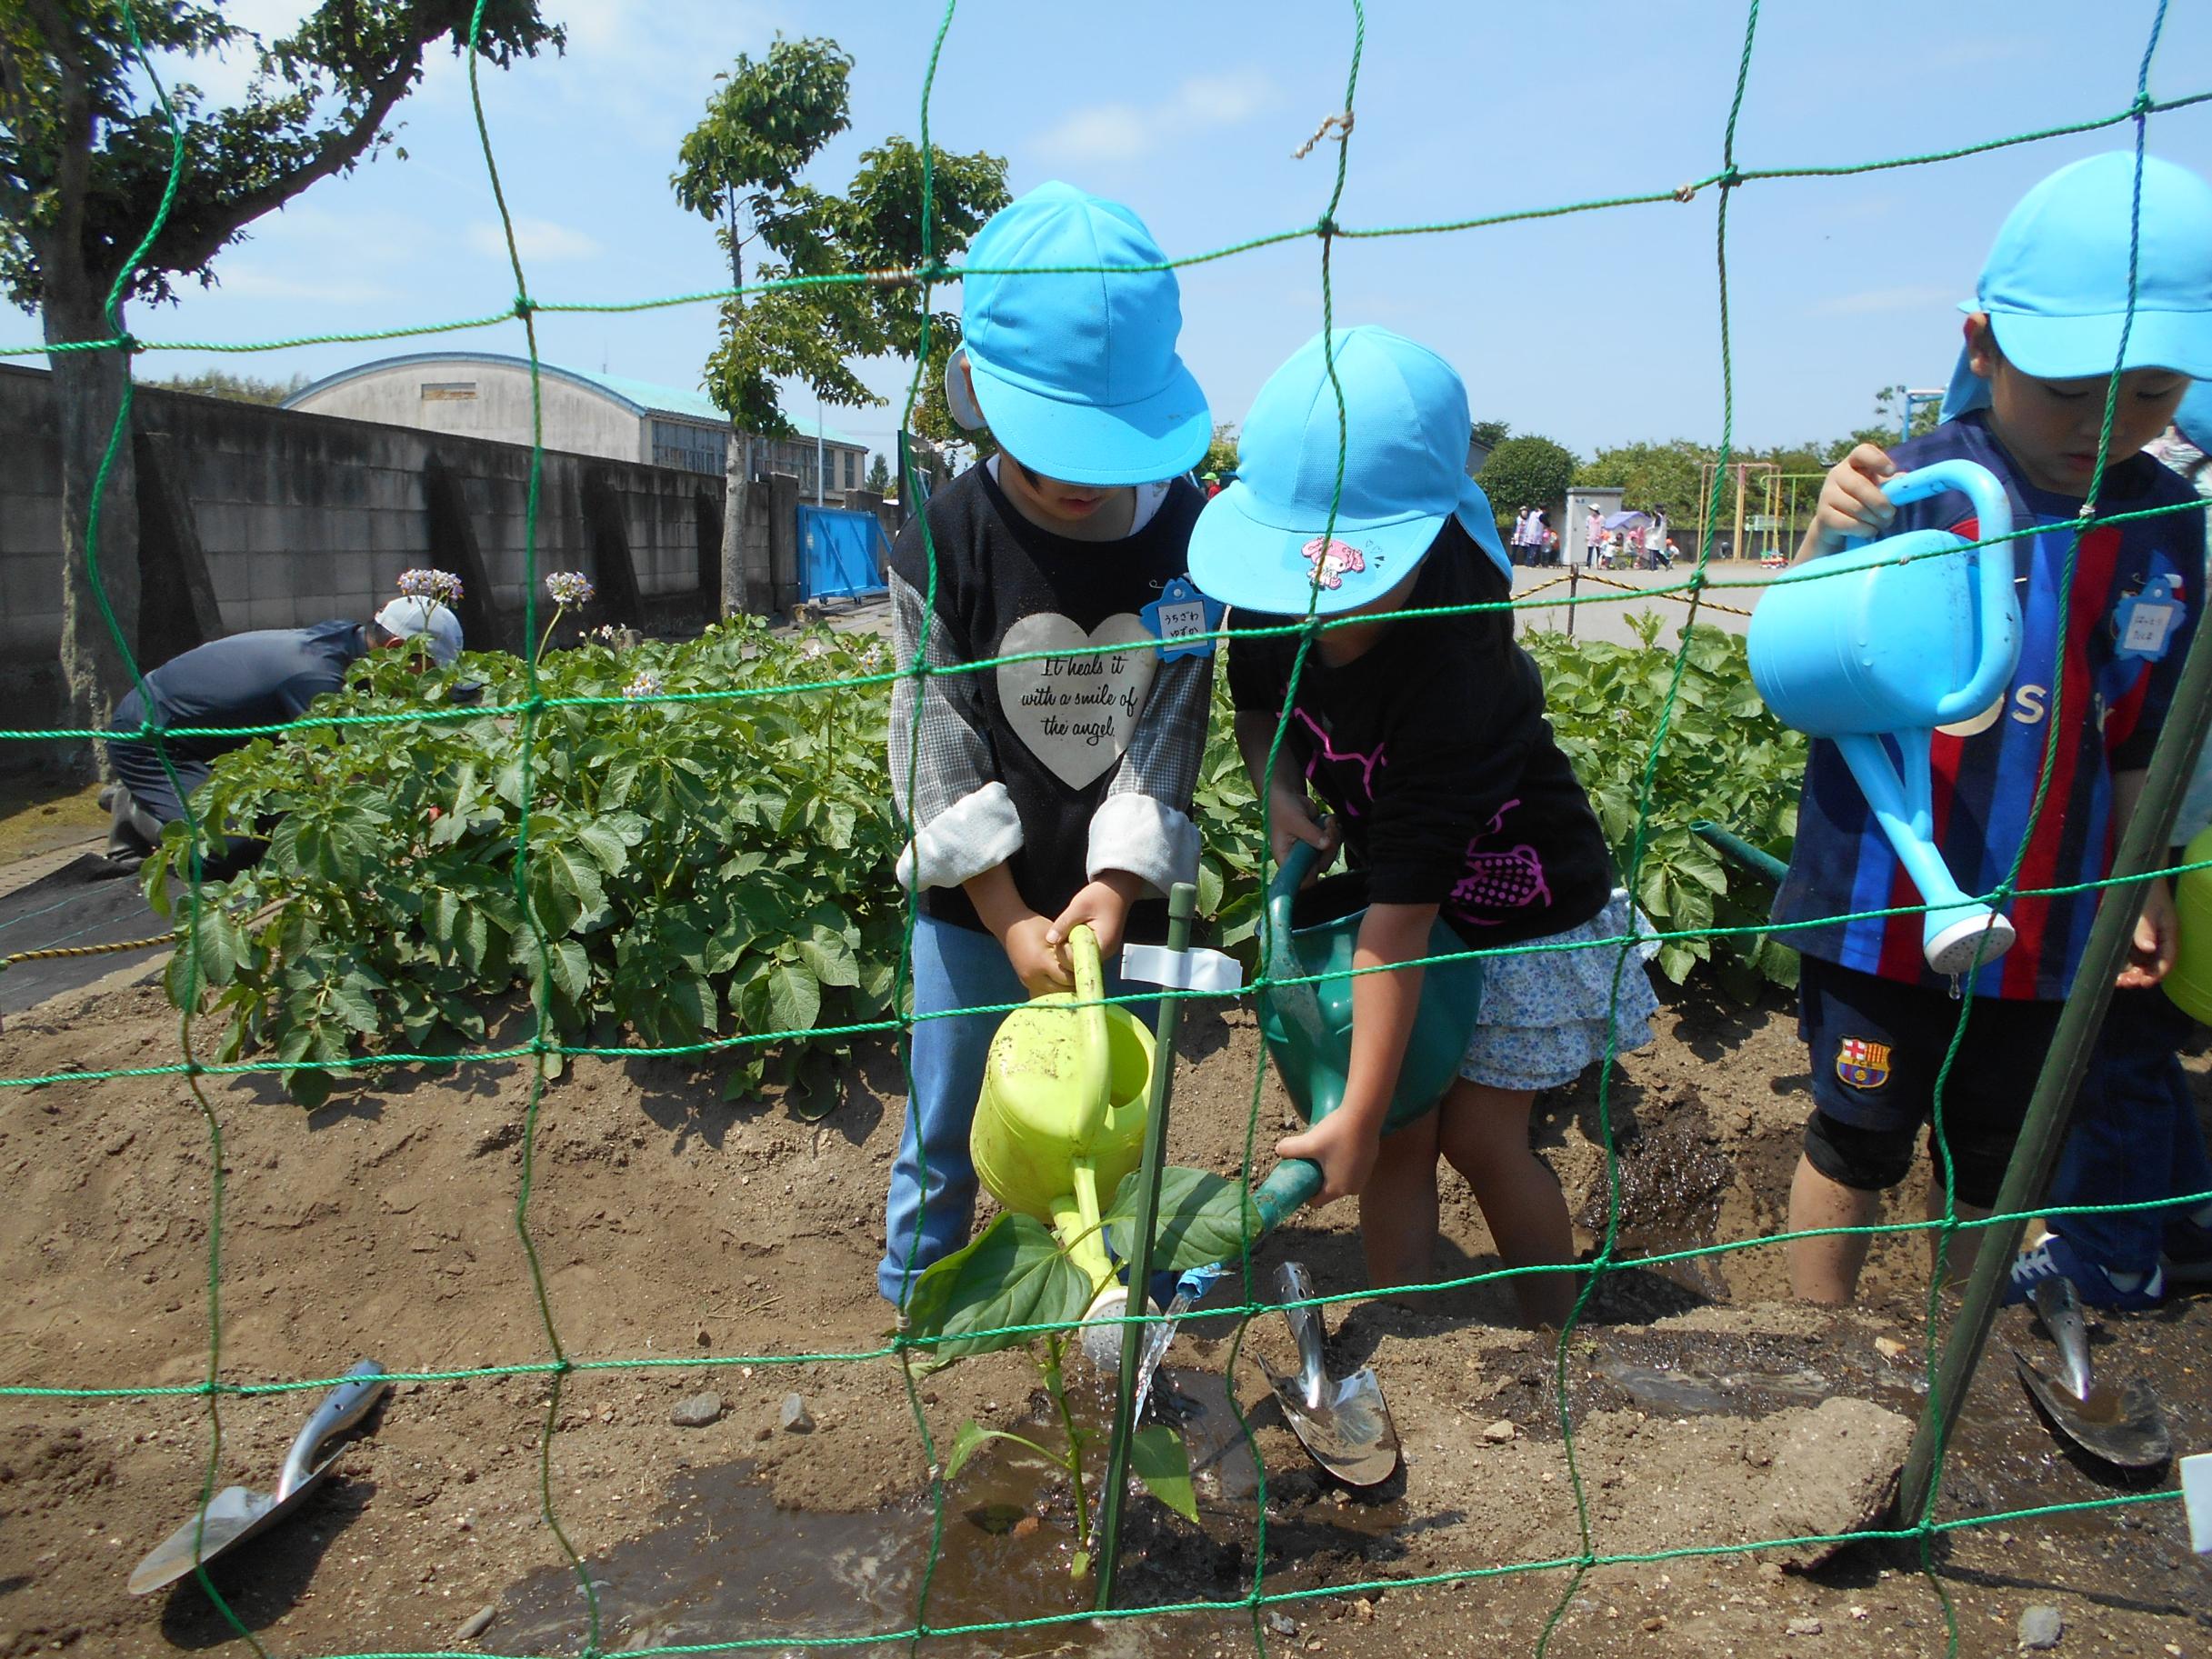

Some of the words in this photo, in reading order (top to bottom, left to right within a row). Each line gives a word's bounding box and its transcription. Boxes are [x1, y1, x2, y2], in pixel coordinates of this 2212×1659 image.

[1040, 655, 1068, 676] It
[1067, 654, 1103, 676] heals
[1111, 655, 1129, 675] it
[1022, 685, 1056, 706] with
[1059, 694, 1072, 705] a
[1074, 684, 1116, 705] smile
[1119, 686, 1138, 717] of
[1040, 715, 1069, 735] the
